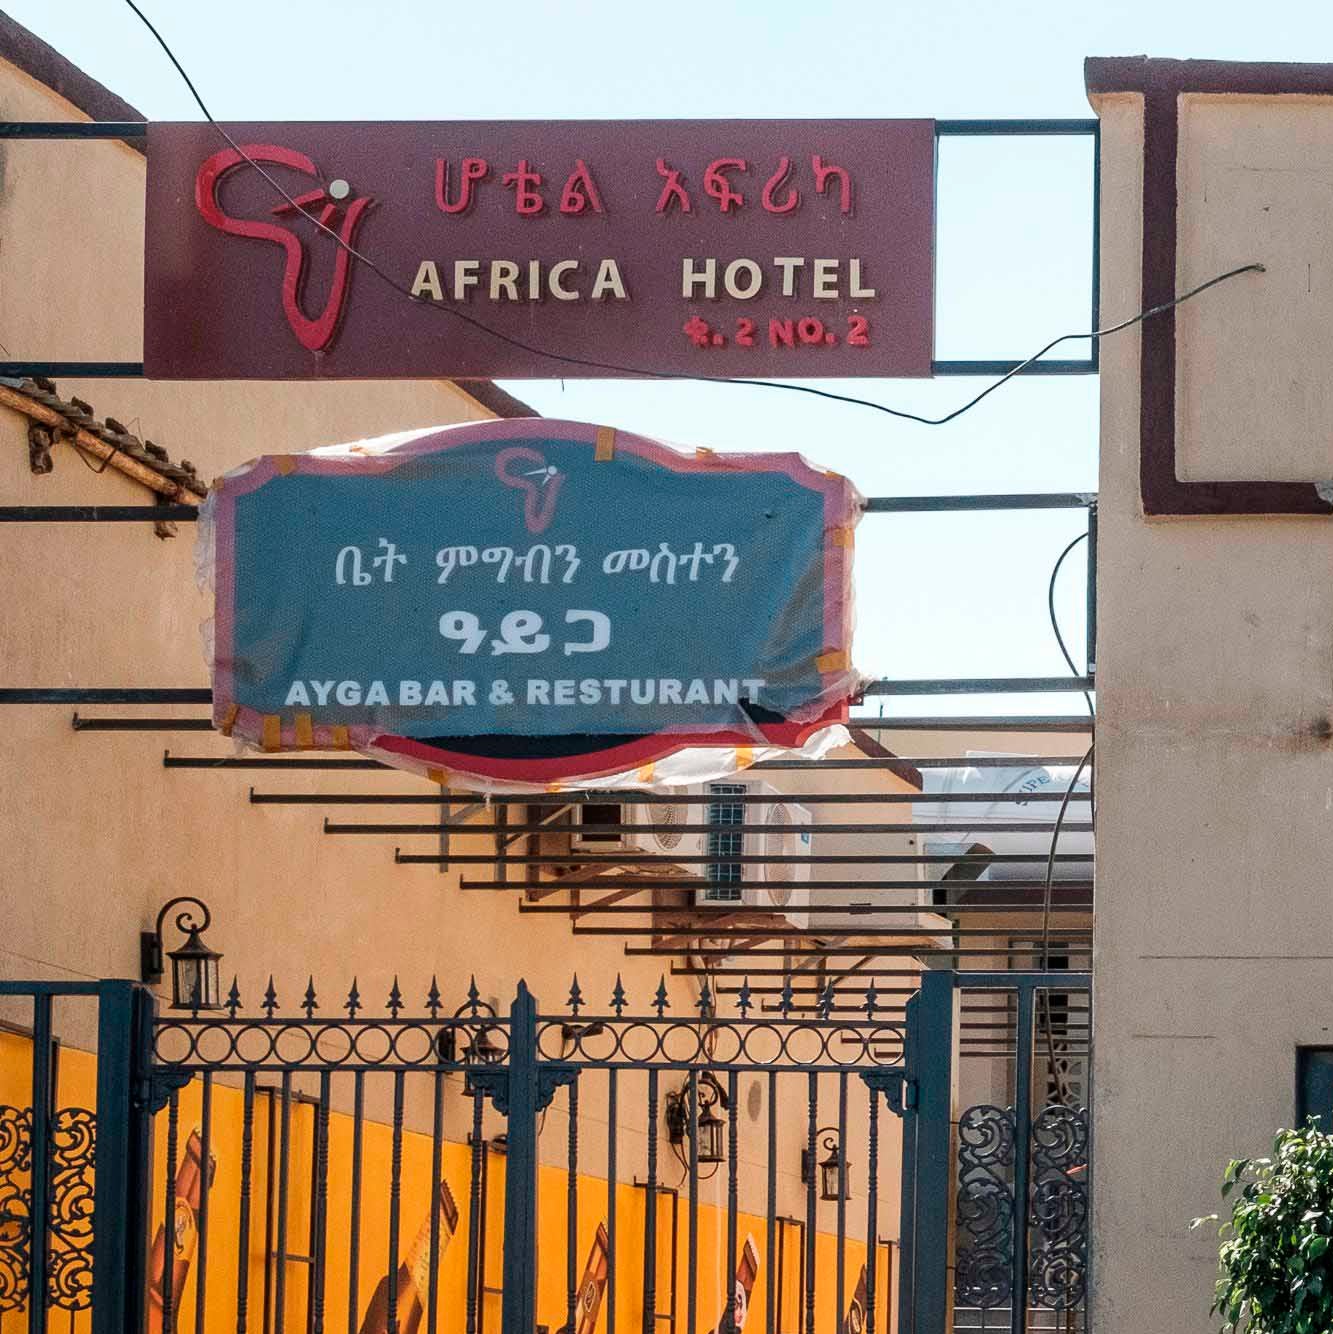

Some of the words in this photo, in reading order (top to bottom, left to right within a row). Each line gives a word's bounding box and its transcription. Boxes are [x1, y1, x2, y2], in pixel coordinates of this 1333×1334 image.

[435, 158, 600, 214] ሆቴል
[410, 258, 626, 300] AFRICA
[682, 257, 876, 300] HOTEL
[735, 317, 754, 346] 2
[768, 317, 837, 348] NO.
[847, 315, 870, 346] 2
[335, 538, 407, 586] ቤት
[436, 544, 581, 584] ምግብን
[602, 542, 740, 585] መስተን
[284, 680, 391, 707] AYGA
[399, 680, 477, 706] BAR
[489, 679, 515, 706] &
[526, 678, 767, 705] RESTURANT
